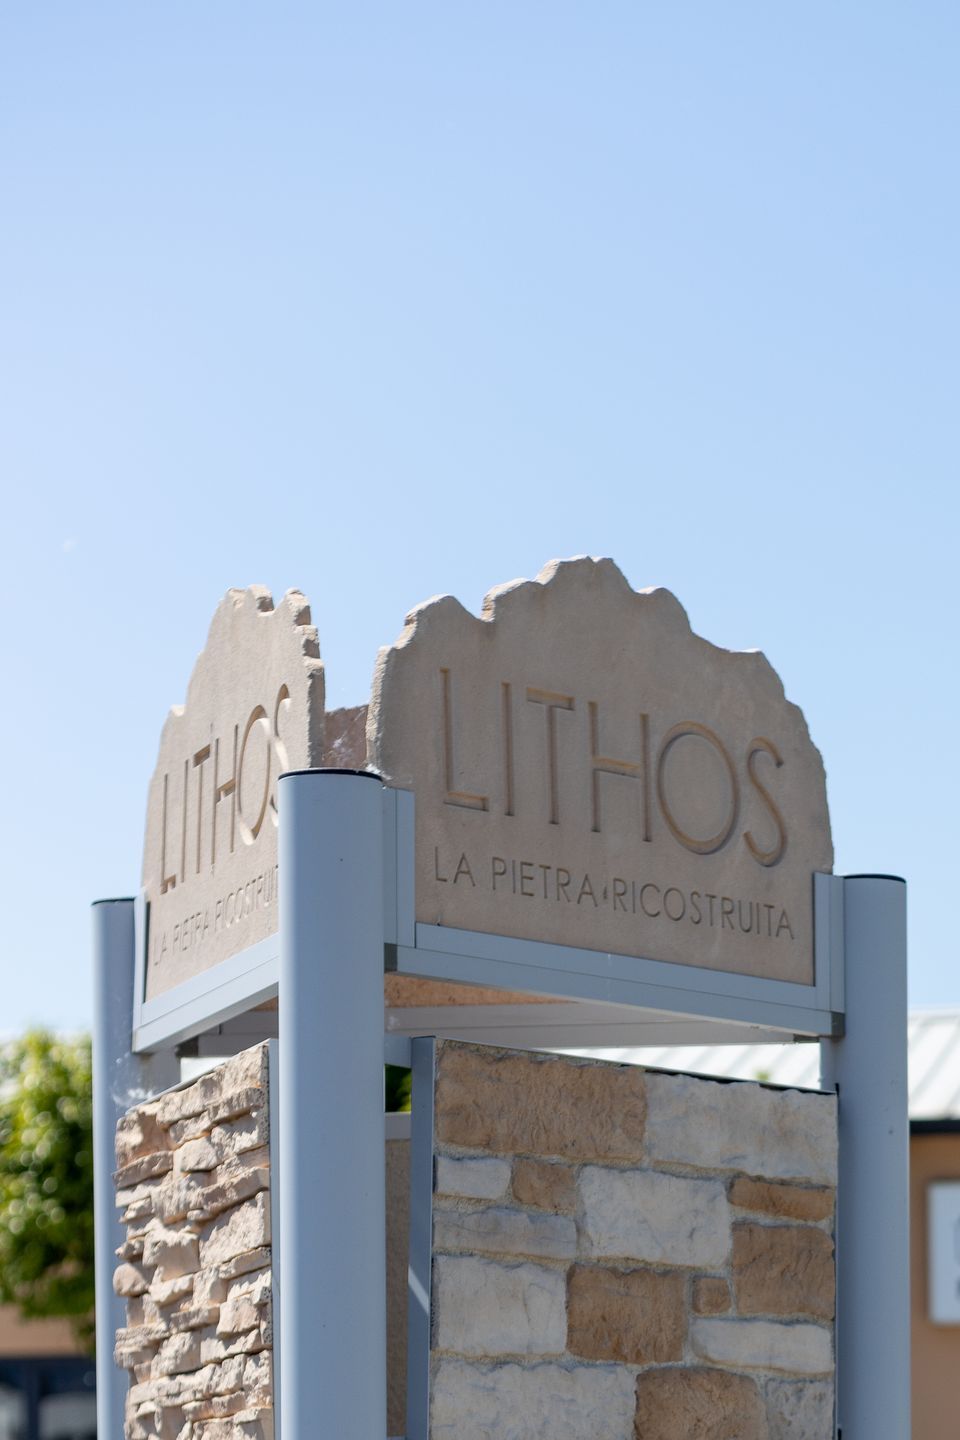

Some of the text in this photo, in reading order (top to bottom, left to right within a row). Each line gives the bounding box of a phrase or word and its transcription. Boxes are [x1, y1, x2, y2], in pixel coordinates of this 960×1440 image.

[438, 667, 787, 868] LITHOS
[434, 846, 796, 941] LA PIETRA RICOSTRUITA
